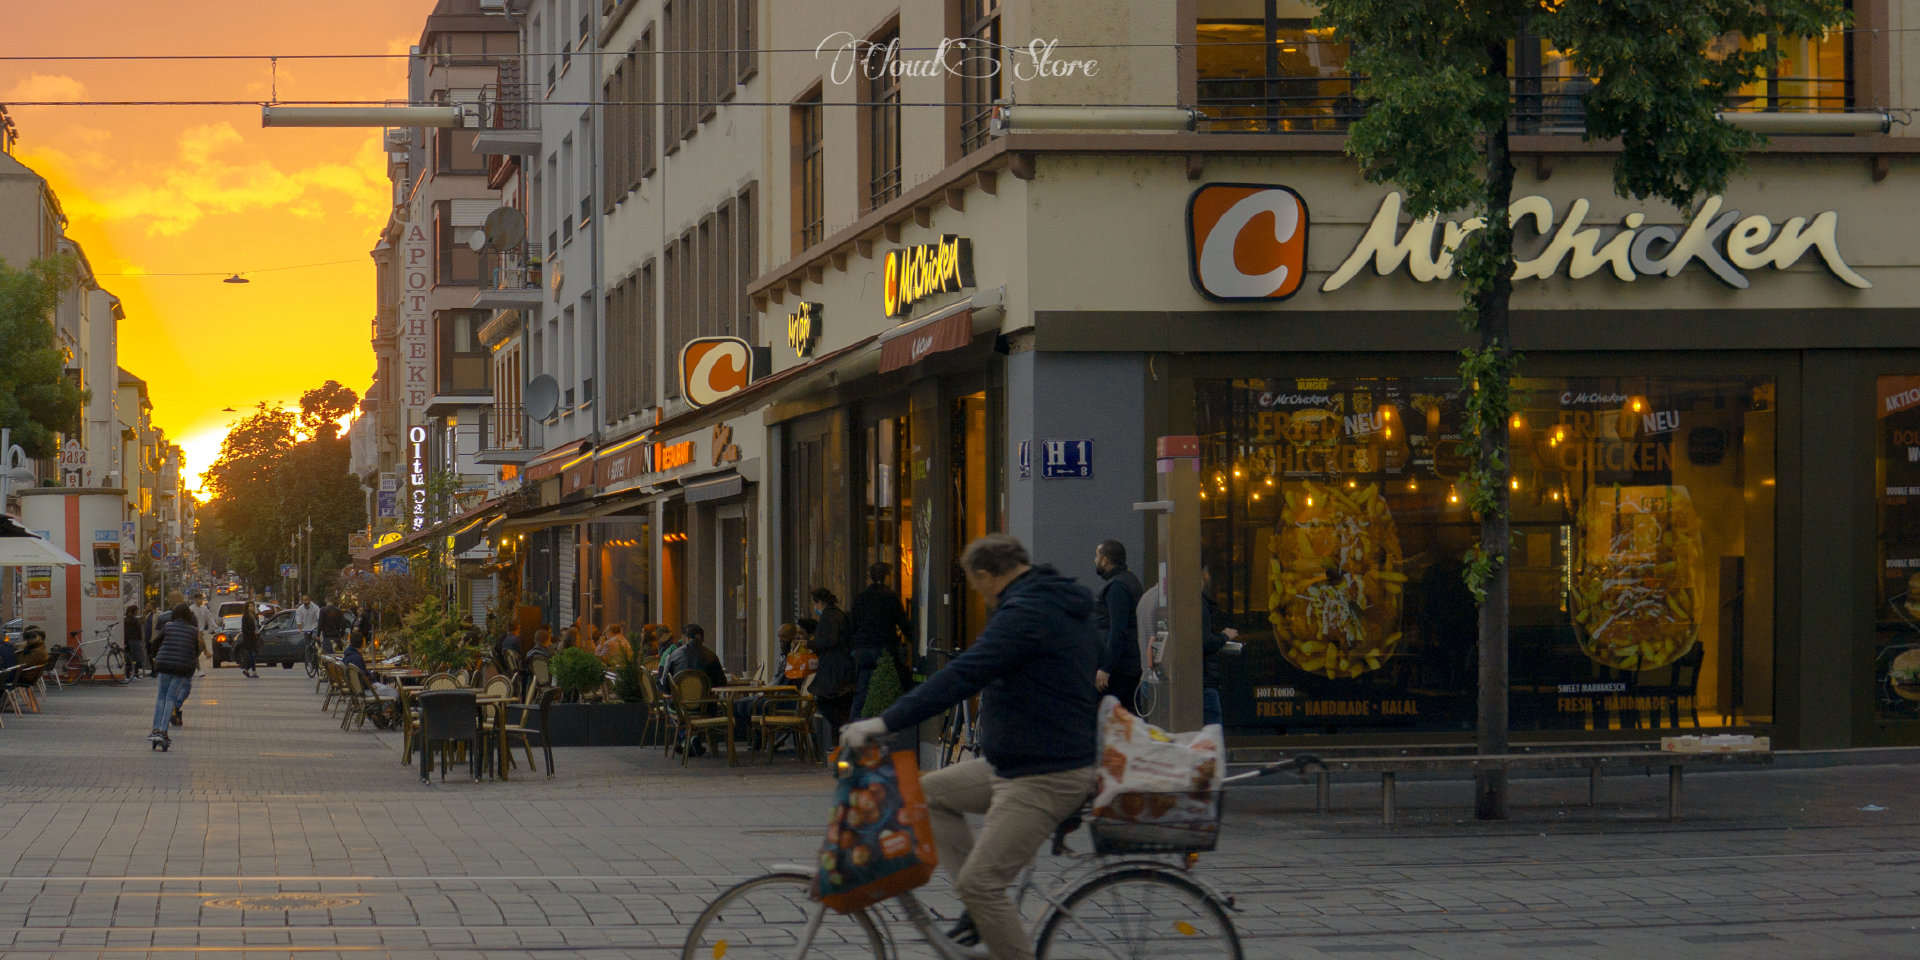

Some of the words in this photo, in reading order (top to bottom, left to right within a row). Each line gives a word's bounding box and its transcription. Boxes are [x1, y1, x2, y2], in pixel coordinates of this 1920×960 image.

[1200, 189, 1299, 297] C
[409, 225, 426, 407] APOTHEKE
[690, 341, 747, 404] C
[1344, 411, 1383, 436] NEU
[1643, 409, 1679, 433] NEU
[1047, 440, 1066, 465] H
[1077, 440, 1088, 465] 1
[1256, 687, 1271, 698] HOT
[1272, 687, 1296, 697] TOKIO
[1557, 697, 1593, 713] FRESH
[1256, 700, 1293, 717] FRESH
[1304, 699, 1369, 716] HANDMADE
[1380, 698, 1418, 716] HALAL
